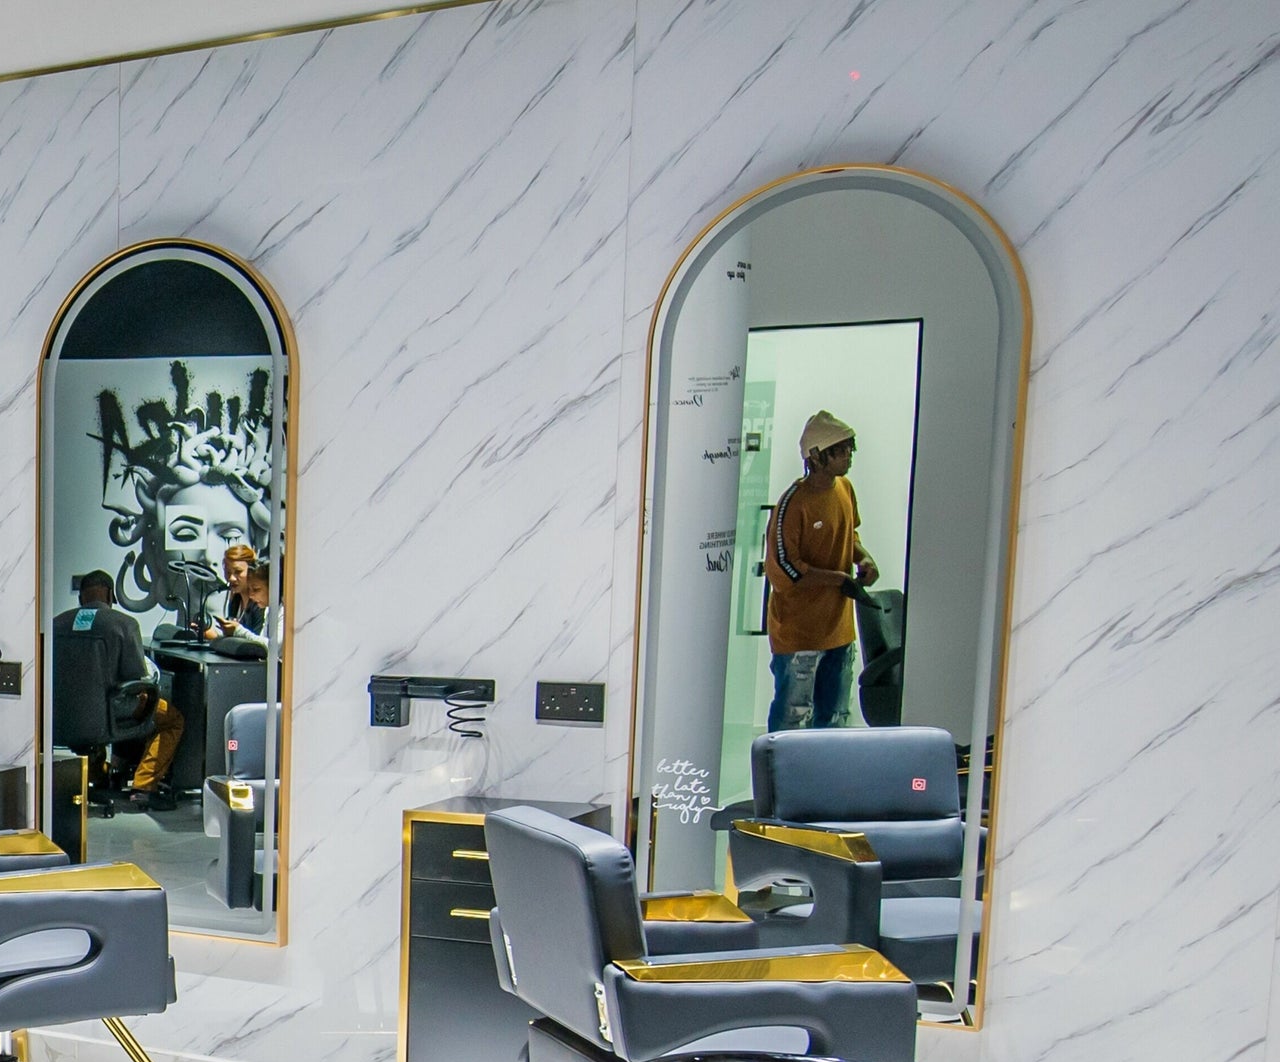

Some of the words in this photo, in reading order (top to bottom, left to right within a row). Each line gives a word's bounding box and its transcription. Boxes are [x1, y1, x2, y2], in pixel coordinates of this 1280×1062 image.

[658, 759, 709, 777] better
[651, 783, 690, 801] than
[675, 776, 710, 793] late
[653, 797, 725, 823] ugly
